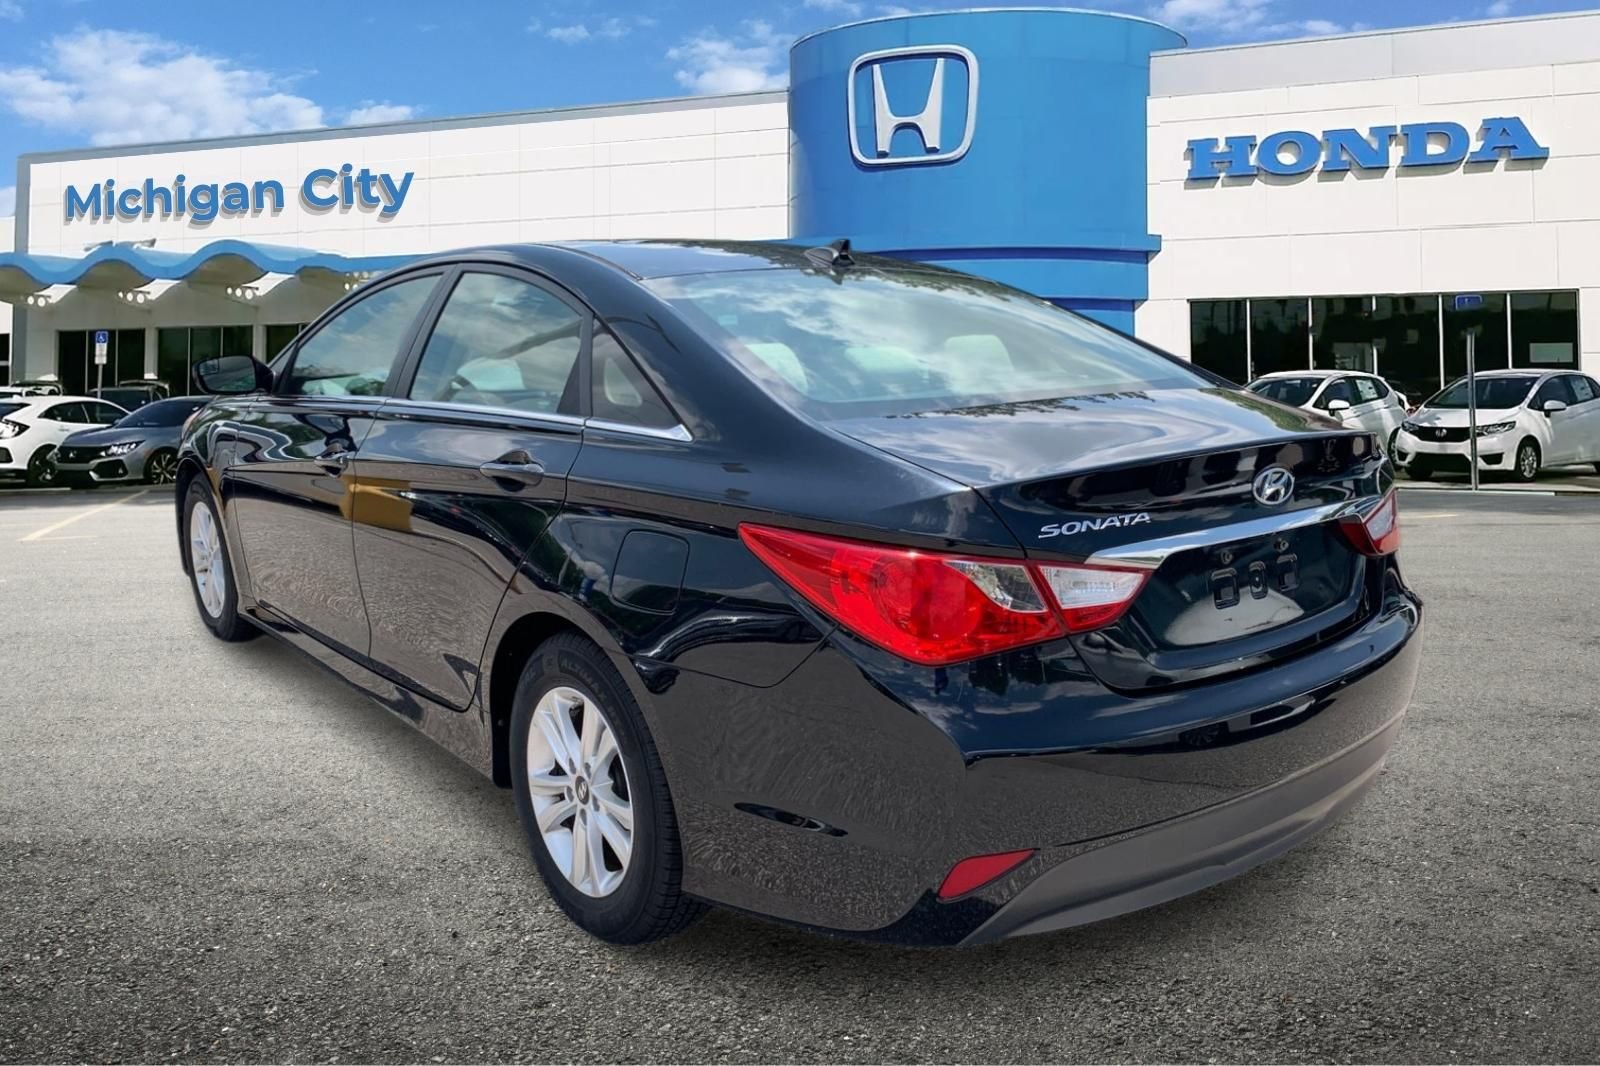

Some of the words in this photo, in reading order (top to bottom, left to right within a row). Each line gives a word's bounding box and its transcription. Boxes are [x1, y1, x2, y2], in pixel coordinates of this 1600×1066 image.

[1185, 116, 1550, 182] HONDA
[65, 173, 285, 223] Michigan
[301, 163, 415, 216] City
[1038, 511, 1152, 539] SONATA
